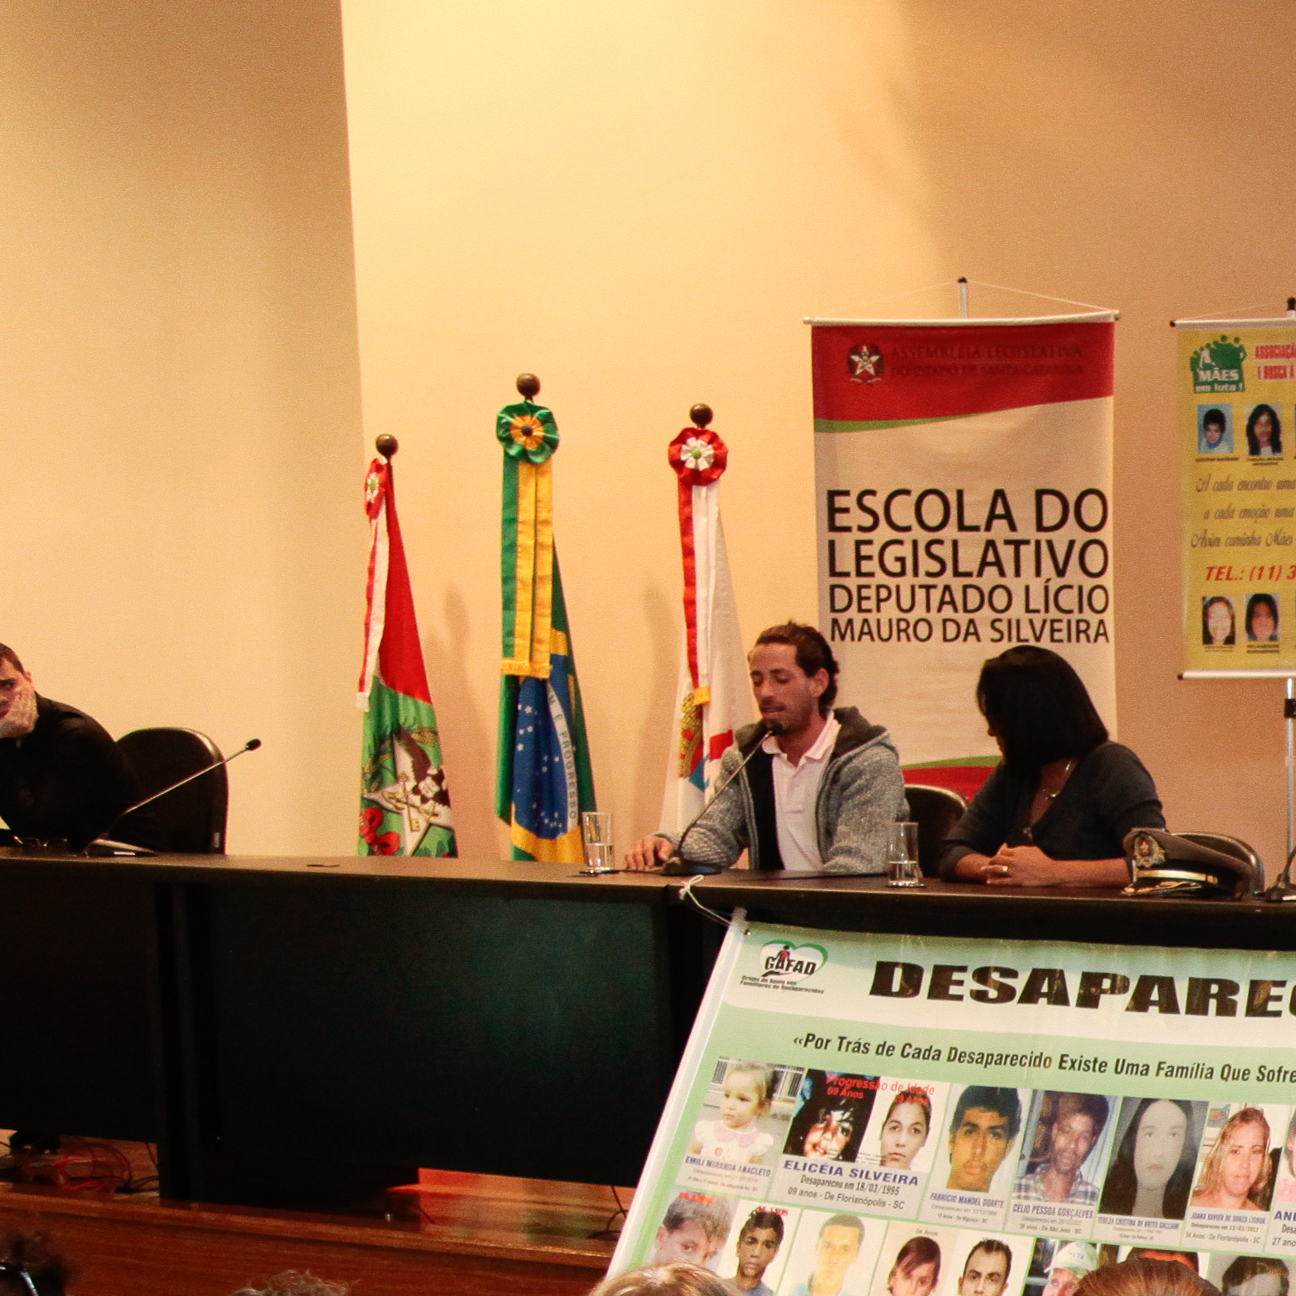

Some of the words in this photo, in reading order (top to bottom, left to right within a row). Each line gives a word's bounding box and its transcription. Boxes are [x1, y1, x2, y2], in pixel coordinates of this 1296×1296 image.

[1199, 368, 1239, 381] MÃES
[827, 488, 1018, 533] ESCOLA
[1034, 488, 1108, 533] DO
[828, 539, 1109, 579] LEGISLATIVO
[1205, 566, 1244, 581] TEL.:
[1250, 565, 1283, 582] (11)
[829, 584, 1013, 614] DEPUTADO
[1024, 578, 1110, 614] LÍCIO
[831, 618, 933, 643] MAURO
[942, 618, 982, 643] DA
[990, 618, 1110, 643] SILVEIRA
[561, 731, 577, 820] PROGRESSO
[764, 956, 817, 975] GAFAD
[837, 1036, 871, 1055] Trás
[875, 1041, 895, 1057] de
[901, 1043, 942, 1062] Cada
[947, 1046, 1053, 1069] Desaparecido
[1058, 1053, 1108, 1073] Existe
[1114, 1058, 1150, 1076] Uma
[1155, 1061, 1214, 1080] Família
[1220, 1064, 1251, 1082] Que
[826, 1073, 888, 1091] Progressão
[891, 1081, 904, 1092] de
[826, 1087, 838, 1096] 09
[840, 1087, 864, 1099] Anos
[784, 1160, 843, 1177] ELICÉIA
[849, 1168, 919, 1186] SILVEIRA
[800, 1175, 843, 1190] Desapareceu
[844, 1181, 854, 1190] em
[788, 1186, 798, 1196] 09
[798, 1190, 817, 1199] anos
[824, 1191, 835, 1200] De
[836, 1193, 886, 1208] Florianópolis
[893, 1200, 905, 1209] SC
[1031, 1205, 1056, 1217] PESSOA
[1272, 1237, 1281, 1246] 27
